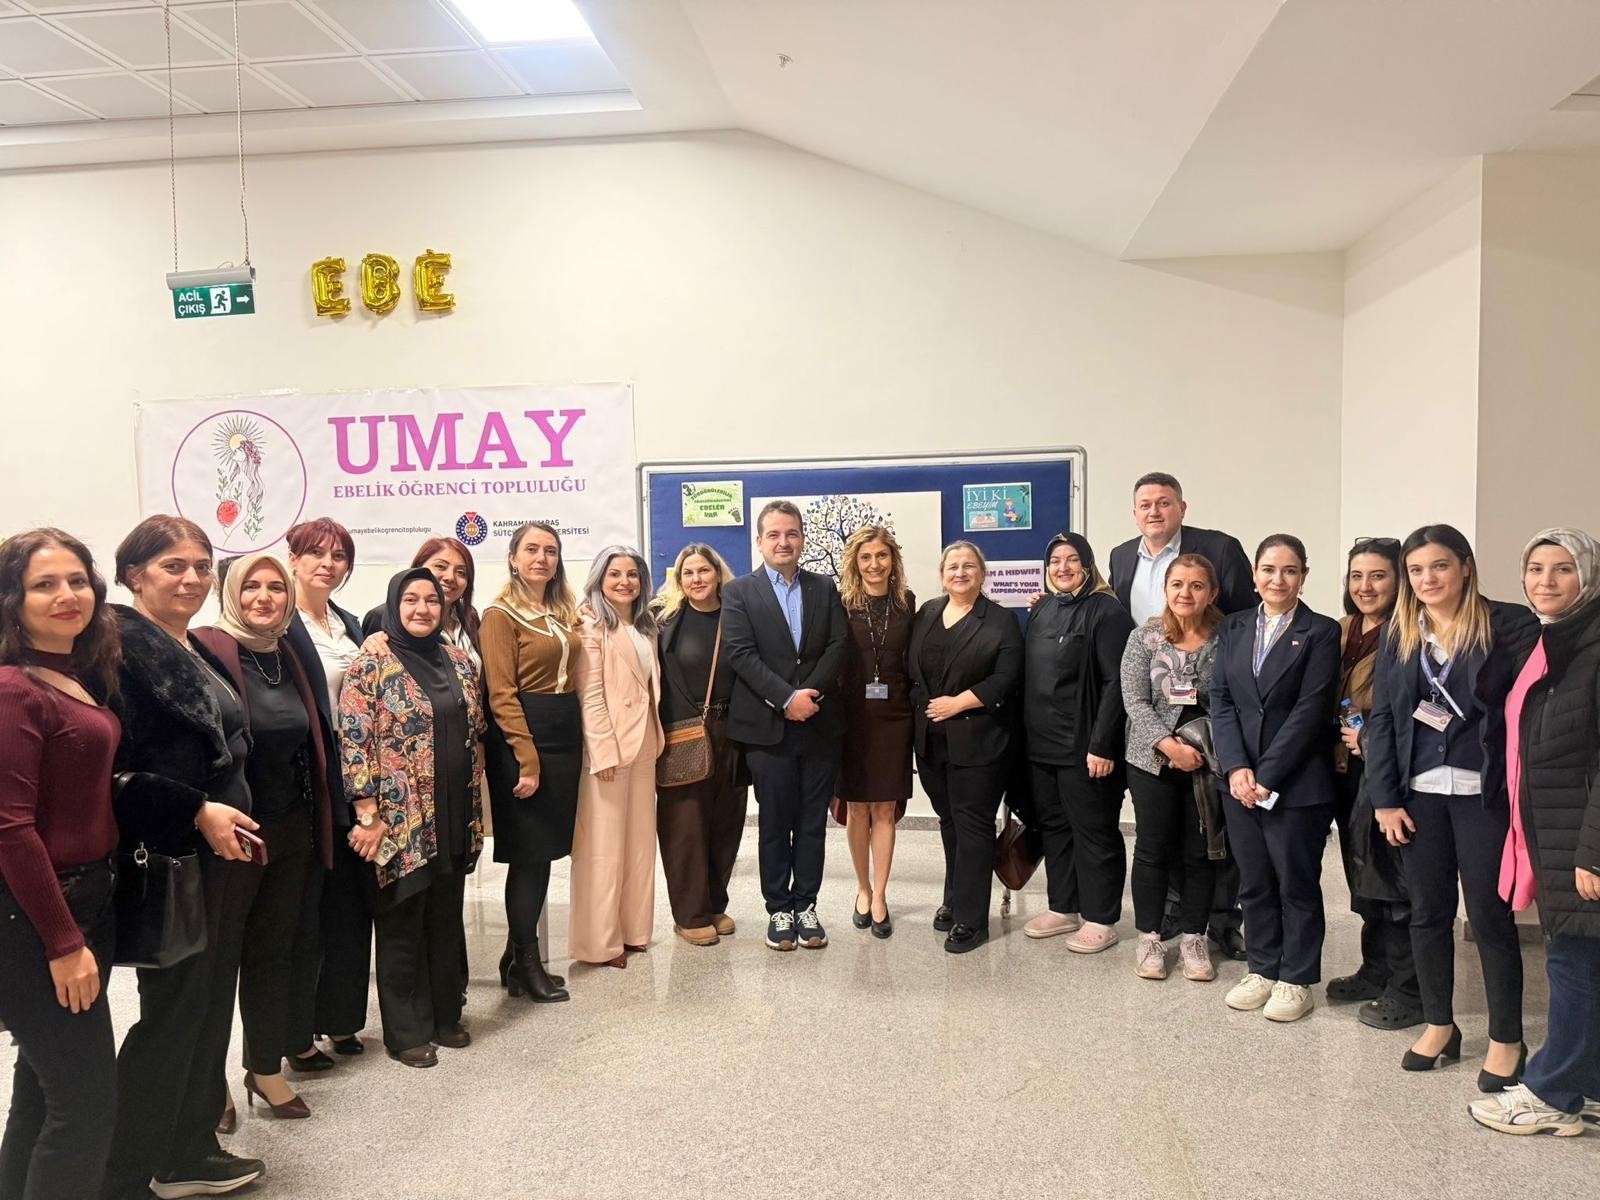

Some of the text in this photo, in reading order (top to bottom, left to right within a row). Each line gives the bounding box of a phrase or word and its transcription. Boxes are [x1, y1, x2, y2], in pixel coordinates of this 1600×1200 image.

[311, 248, 456, 317] EBE
[178, 290, 204, 302] ACİL
[178, 303, 207, 317] ÇIKIŞ
[328, 409, 586, 475] UMAY
[333, 476, 587, 498] EBELİK ÖĞRENCİ TOPLULUĞU
[966, 486, 1007, 501] İYİ Kİ
[493, 527, 590, 537] SÜTÇ ERSİTESİ
[1005, 568, 1041, 576] MIDWIFE
